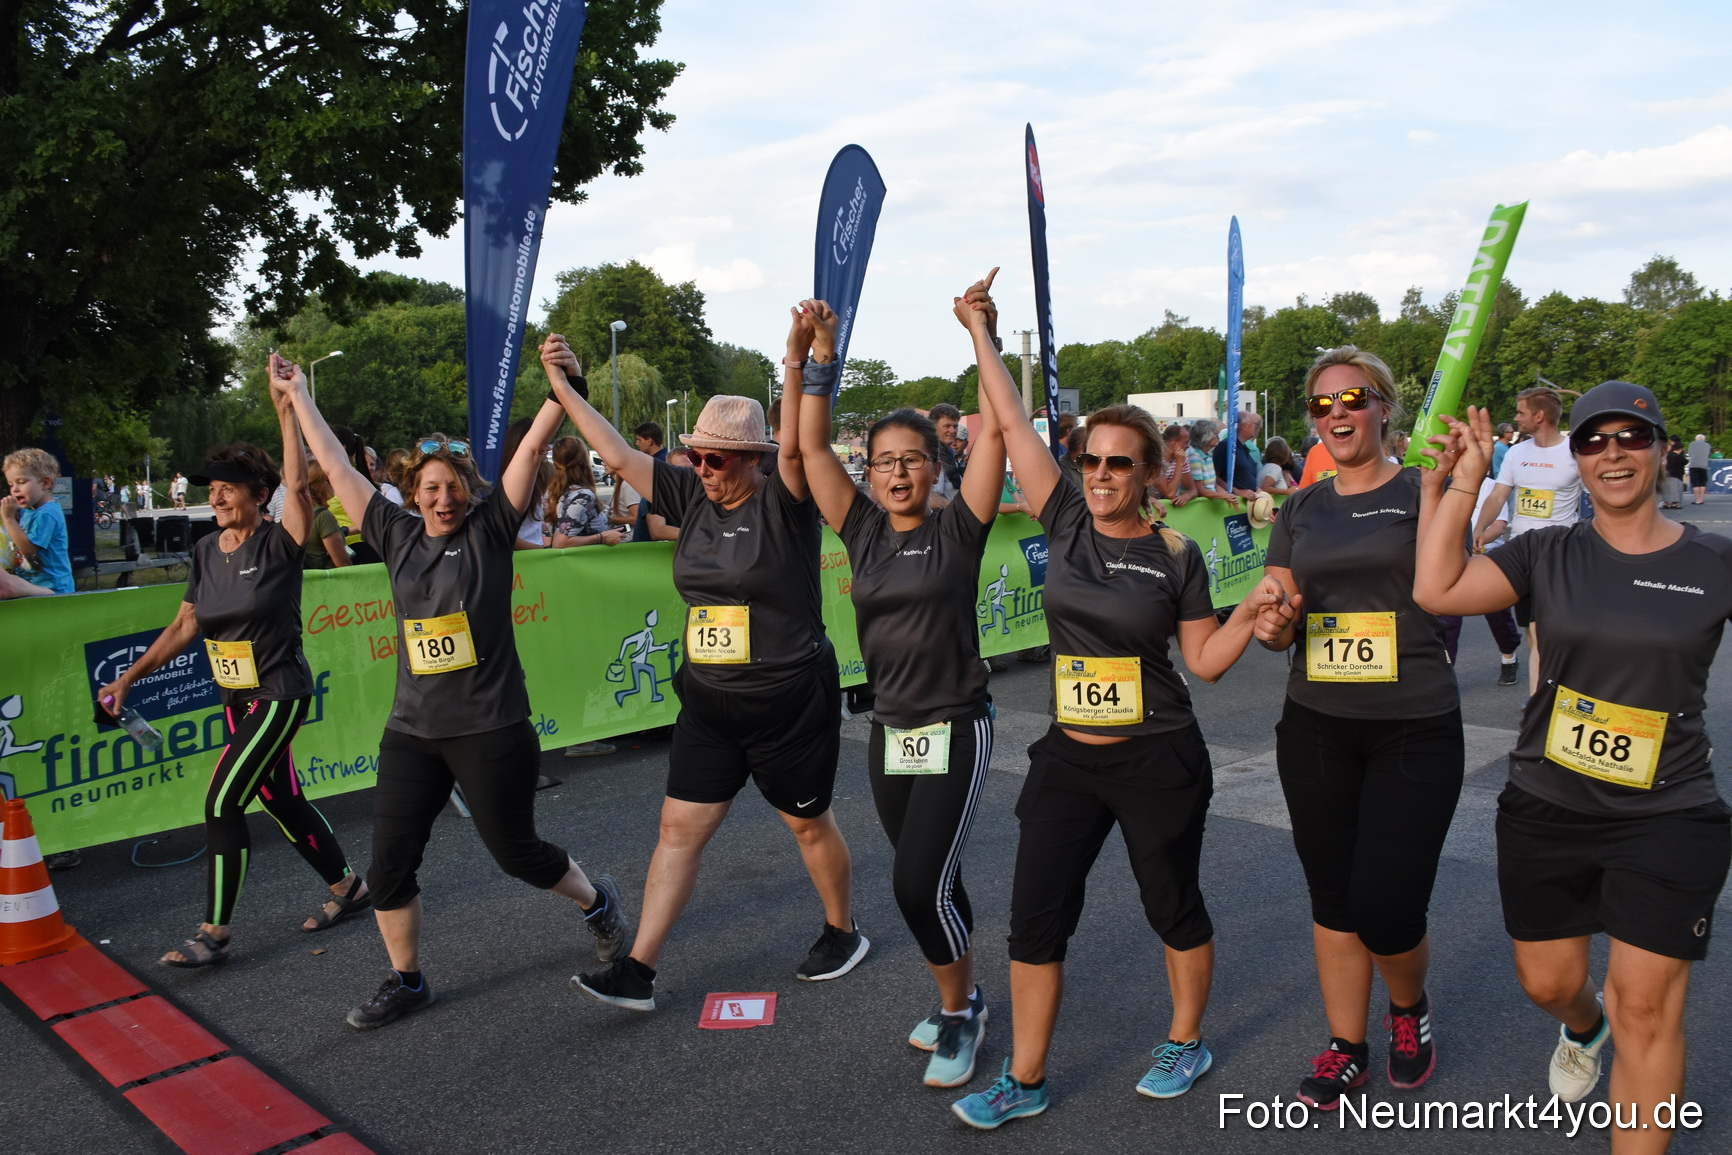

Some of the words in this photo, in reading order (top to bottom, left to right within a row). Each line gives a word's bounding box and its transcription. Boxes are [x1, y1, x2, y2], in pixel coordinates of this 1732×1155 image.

[840, 176, 864, 252] Fischer
[849, 193, 867, 251] AUTOMOBILE
[486, 210, 536, 450] www.fischer-automobile.de
[838, 305, 853, 357] mobile.de
[1521, 498, 1547, 510] 1144
[1032, 548, 1049, 560] Fisc
[1105, 561, 1127, 569] Claudia
[1222, 543, 1268, 578] firmenla
[1633, 579, 1667, 590] Nathalie
[1667, 584, 1705, 595] Macfalda
[1015, 612, 1045, 629] neuma
[417, 636, 456, 659] 180
[697, 627, 732, 647] 153
[1323, 638, 1374, 662] 176
[130, 667, 194, 687] UTOMOBILE
[215, 657, 240, 676] 151
[161, 686, 179, 697] das
[1072, 682, 1121, 706] 164
[1063, 705, 1104, 715] Königsberger
[1571, 723, 1632, 762] 168
[1561, 745, 1596, 764] Macfalda
[1598, 759, 1635, 773] Nathalie
[52, 761, 185, 813] neumarkt
